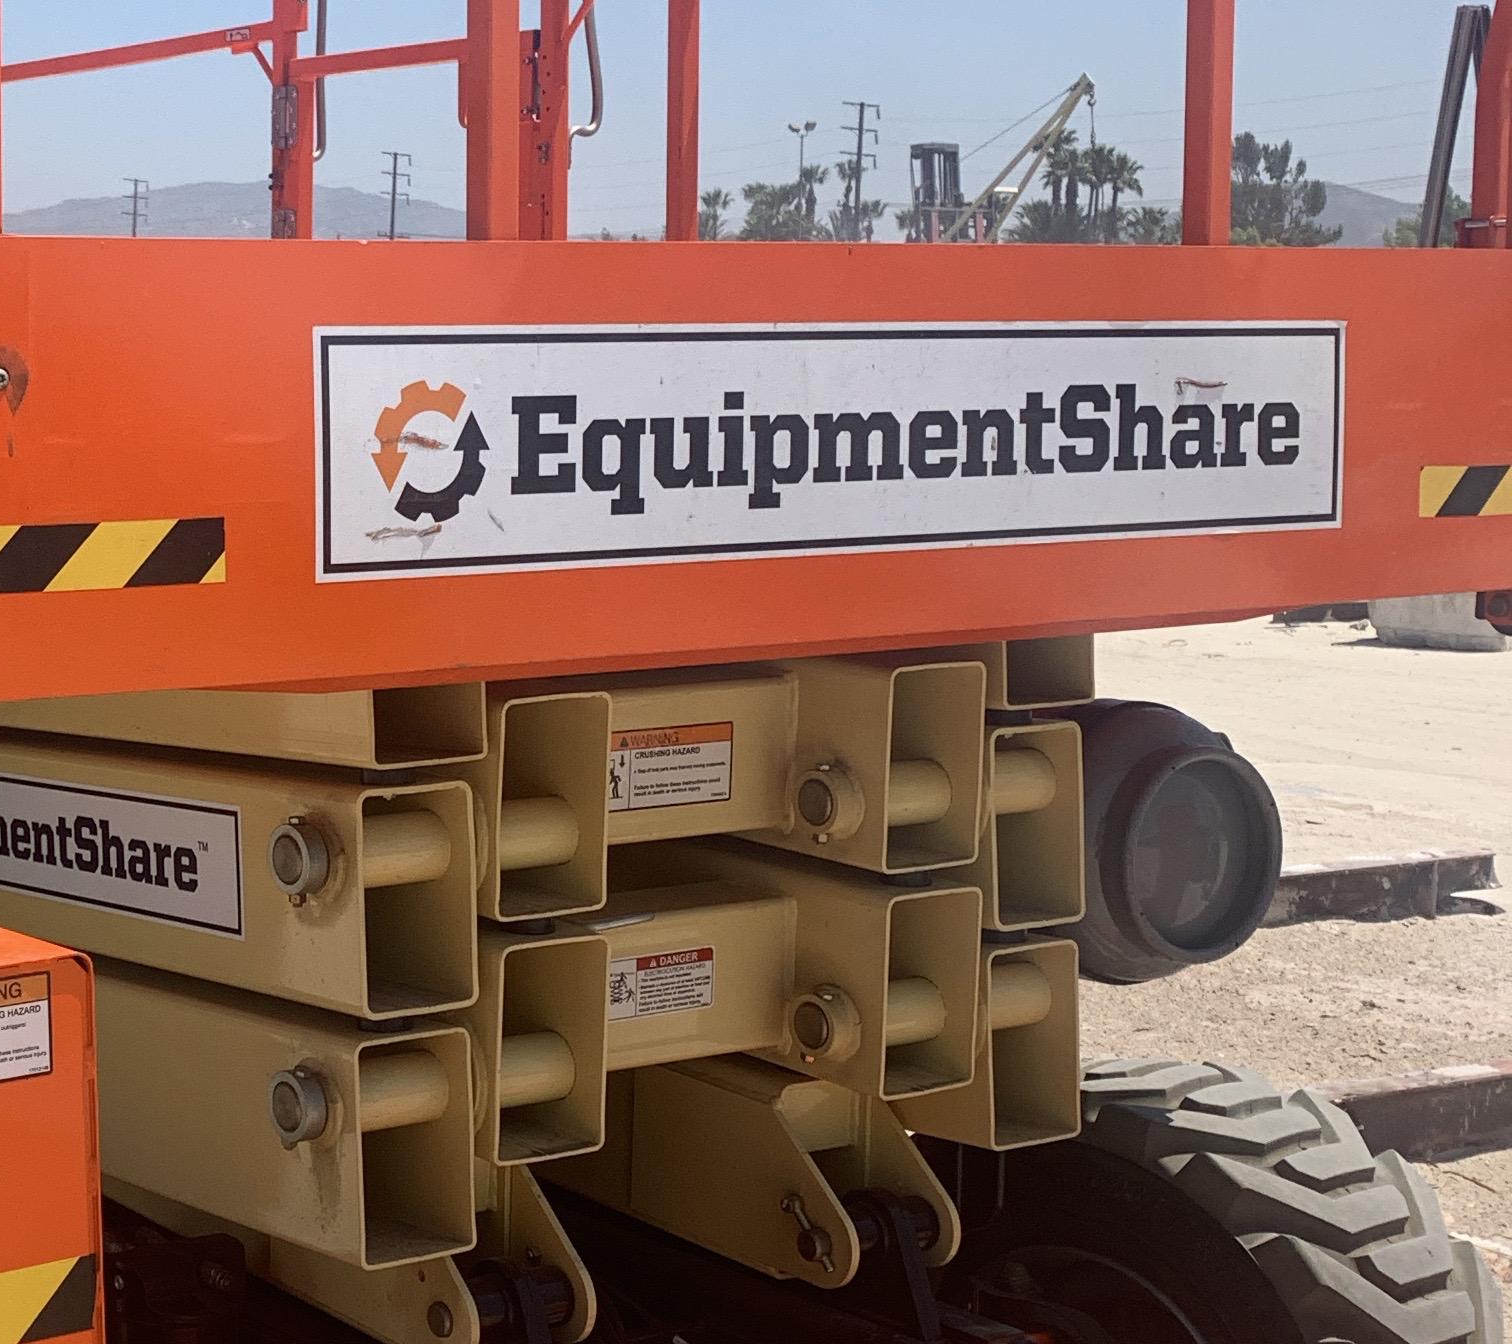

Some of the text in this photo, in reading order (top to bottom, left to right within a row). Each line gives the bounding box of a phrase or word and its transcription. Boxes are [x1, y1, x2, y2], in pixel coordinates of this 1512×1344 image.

[510, 383, 1300, 515] EquipmentShare
[659, 952, 698, 966] DANGER
[7, 1004, 41, 1017] HAZARD
